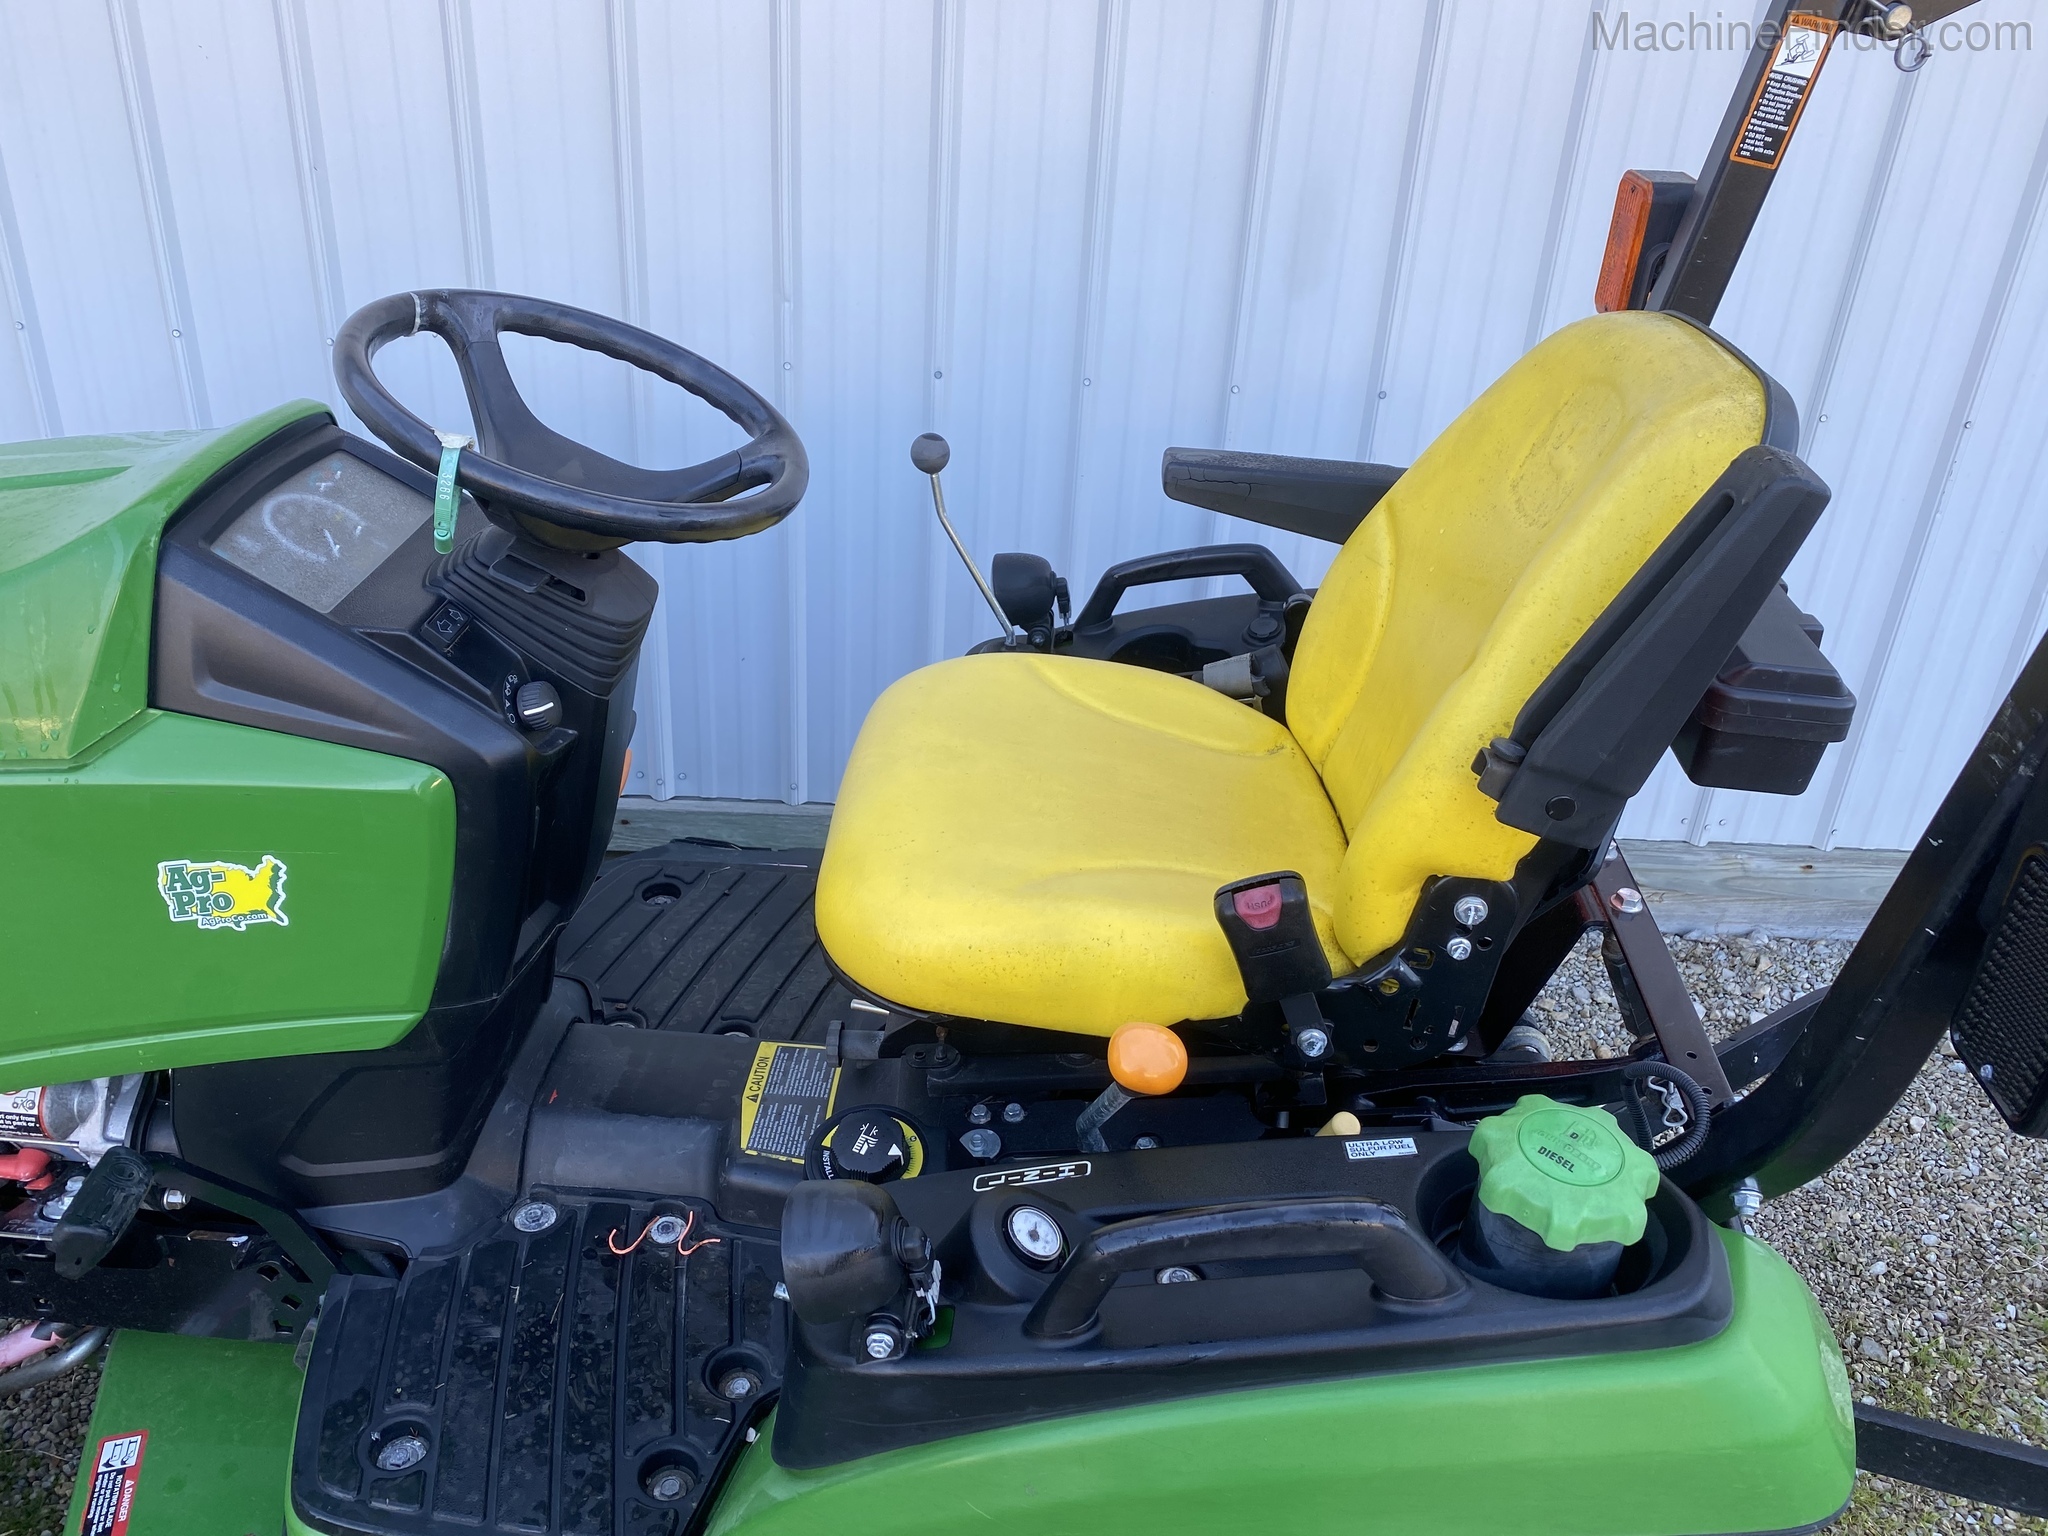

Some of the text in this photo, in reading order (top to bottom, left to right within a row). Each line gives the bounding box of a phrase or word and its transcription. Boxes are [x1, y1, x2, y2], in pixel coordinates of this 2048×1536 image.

[440, 472, 452, 500] 3266
[167, 866, 224, 894] Ag-
[172, 892, 233, 917] Pro
[201, 912, 269, 927] AgProCo.com
[749, 1056, 770, 1092] CAUTION
[822, 1150, 835, 1180] INSTALL
[1538, 1146, 1575, 1173] DIESEL
[110, 1475, 123, 1506] ROTATING
[118, 1488, 132, 1522] DANGER
